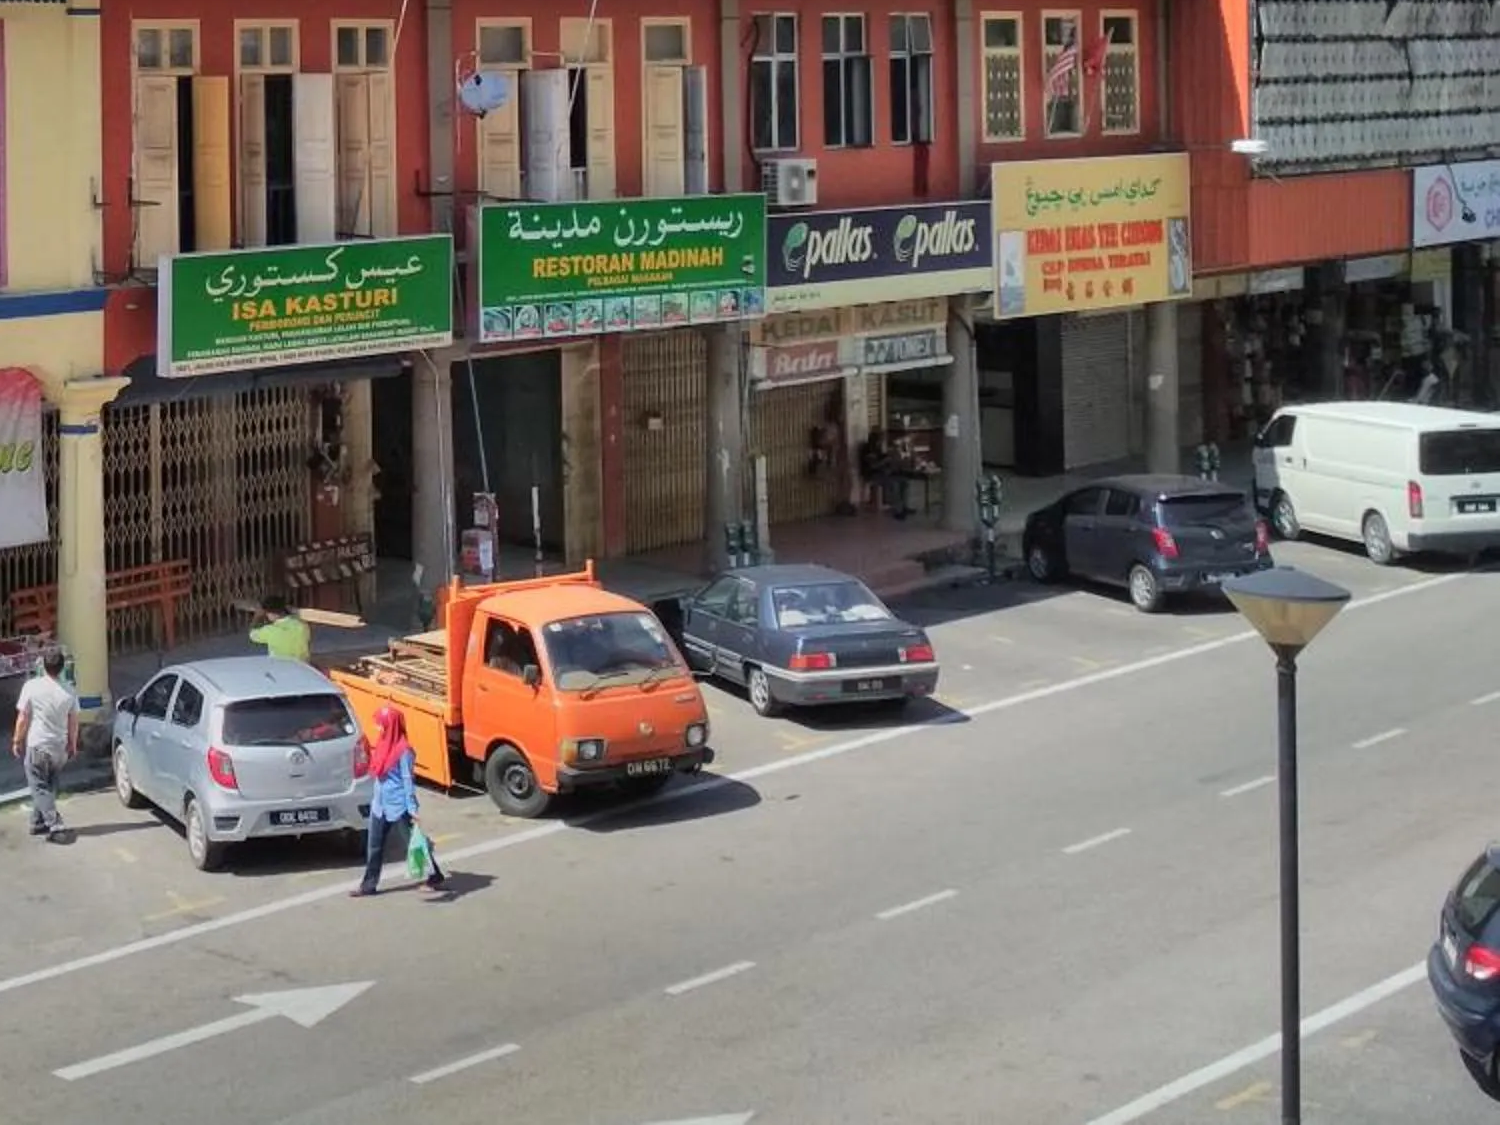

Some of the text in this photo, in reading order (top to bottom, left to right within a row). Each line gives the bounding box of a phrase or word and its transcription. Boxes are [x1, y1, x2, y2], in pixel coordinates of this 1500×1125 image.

[532, 247, 724, 278] RESTORAN MADINAH
[231, 287, 398, 321] ISA KASTURI
